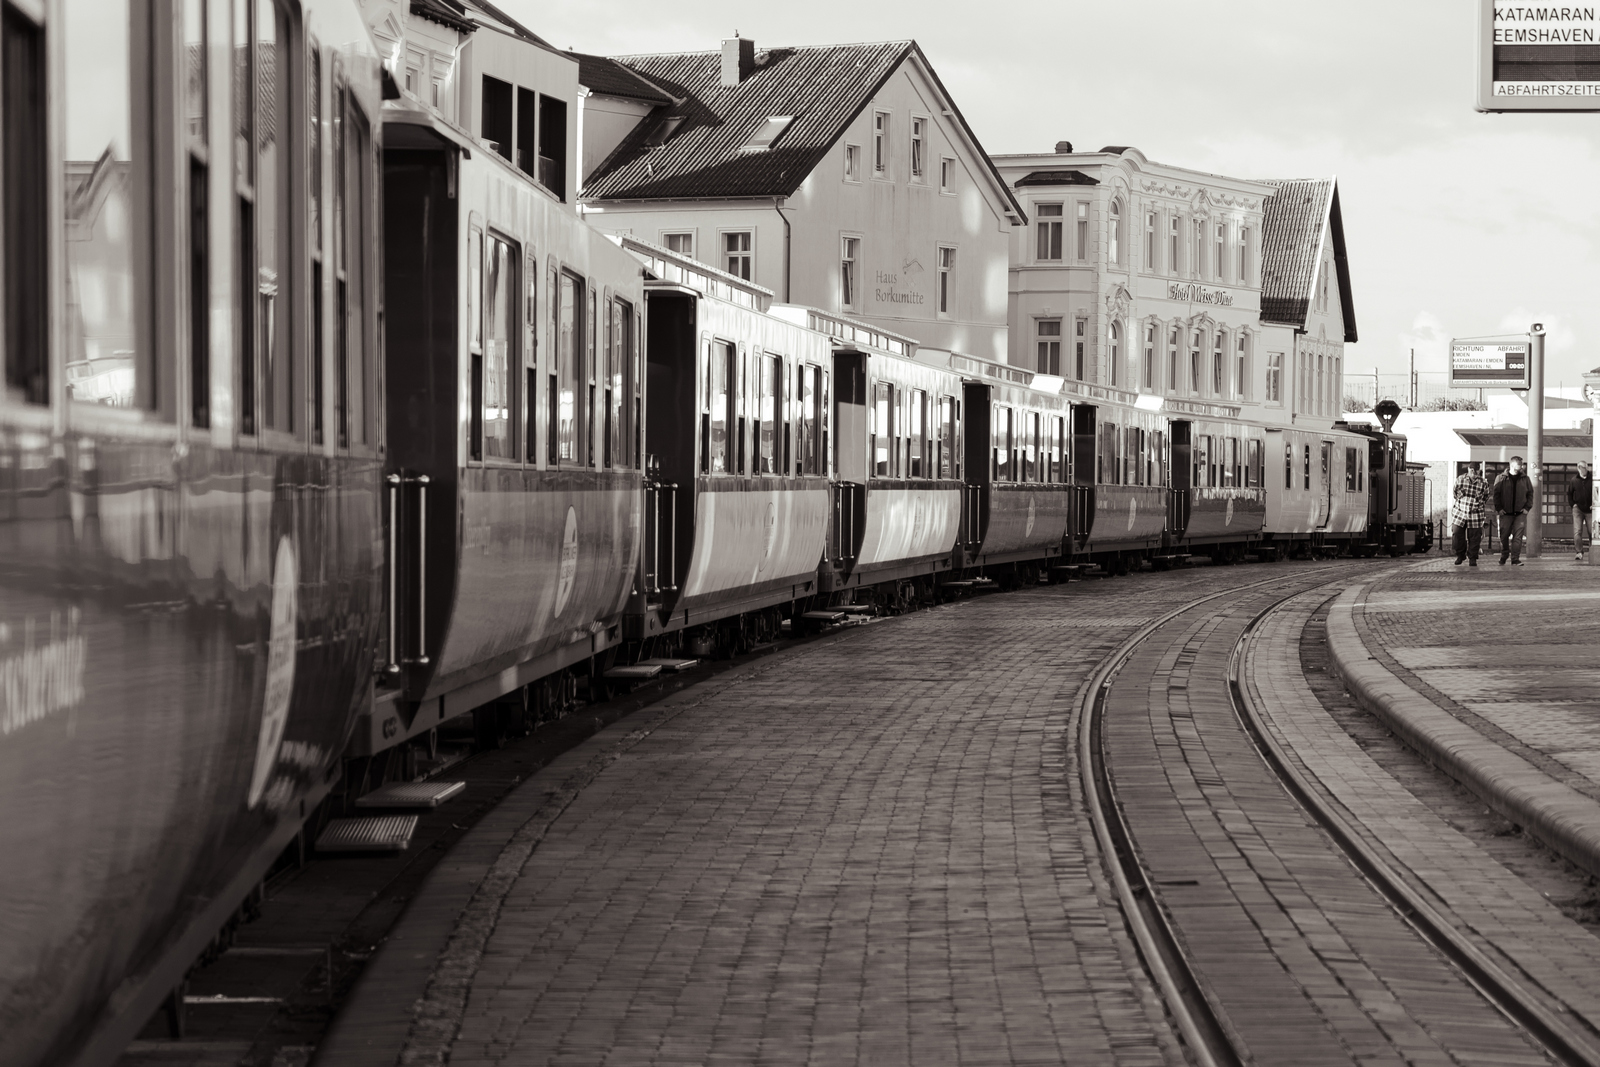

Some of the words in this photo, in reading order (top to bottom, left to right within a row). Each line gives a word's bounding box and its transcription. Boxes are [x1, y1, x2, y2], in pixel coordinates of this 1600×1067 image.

[1494, 8, 1594, 21] KATAMARAN
[1494, 29, 1594, 42] EEMSHAVEN
[1498, 85, 1600, 95] ABFAHRTSZEITE
[876, 270, 898, 284] Haus
[876, 286, 924, 304] Borkumitte
